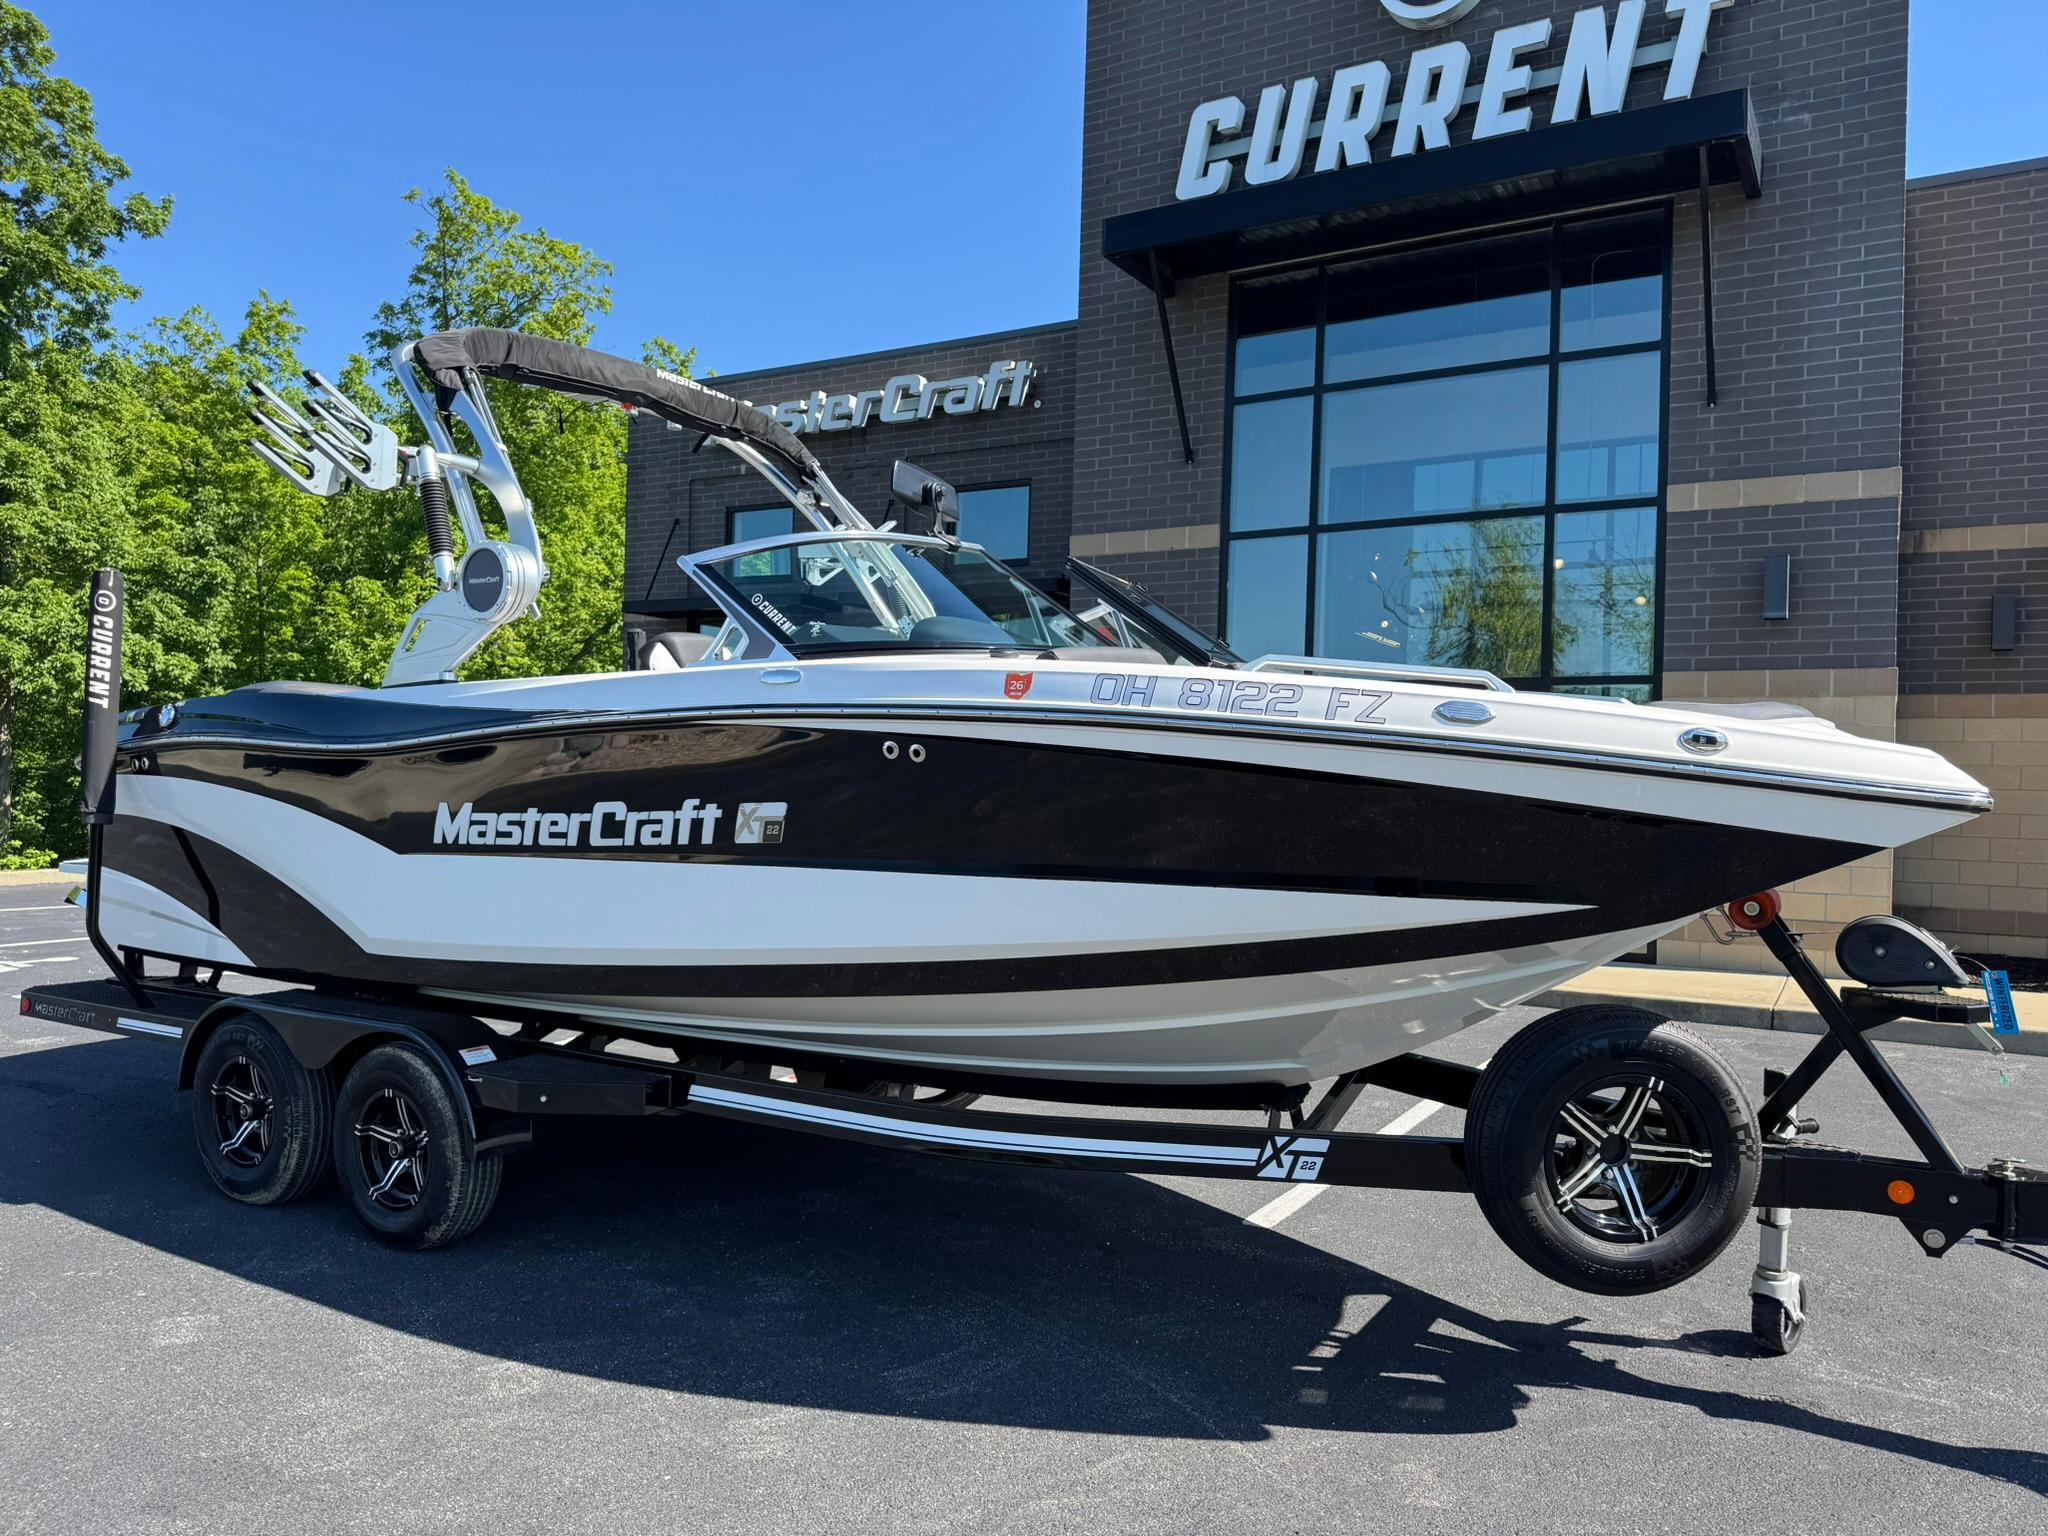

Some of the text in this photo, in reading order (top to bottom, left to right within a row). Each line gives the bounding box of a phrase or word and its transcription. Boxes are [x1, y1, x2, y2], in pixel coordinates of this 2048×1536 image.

[1175, 0, 1734, 201] CURRENT
[656, 368, 735, 402] MasterC
[748, 359, 1036, 437] sterCraft
[758, 601, 797, 635] CURRENT
[88, 614, 114, 709] CURRENT
[1009, 680, 1024, 690] 26
[1090, 673, 1394, 725] OH 8122 FZ
[433, 798, 723, 847] MasterCraft
[766, 824, 780, 835] 22
[34, 1001, 96, 1024] MasterCraft
[1993, 977, 2014, 1030] WINTERIZED
[1300, 1160, 1317, 1171] 22
